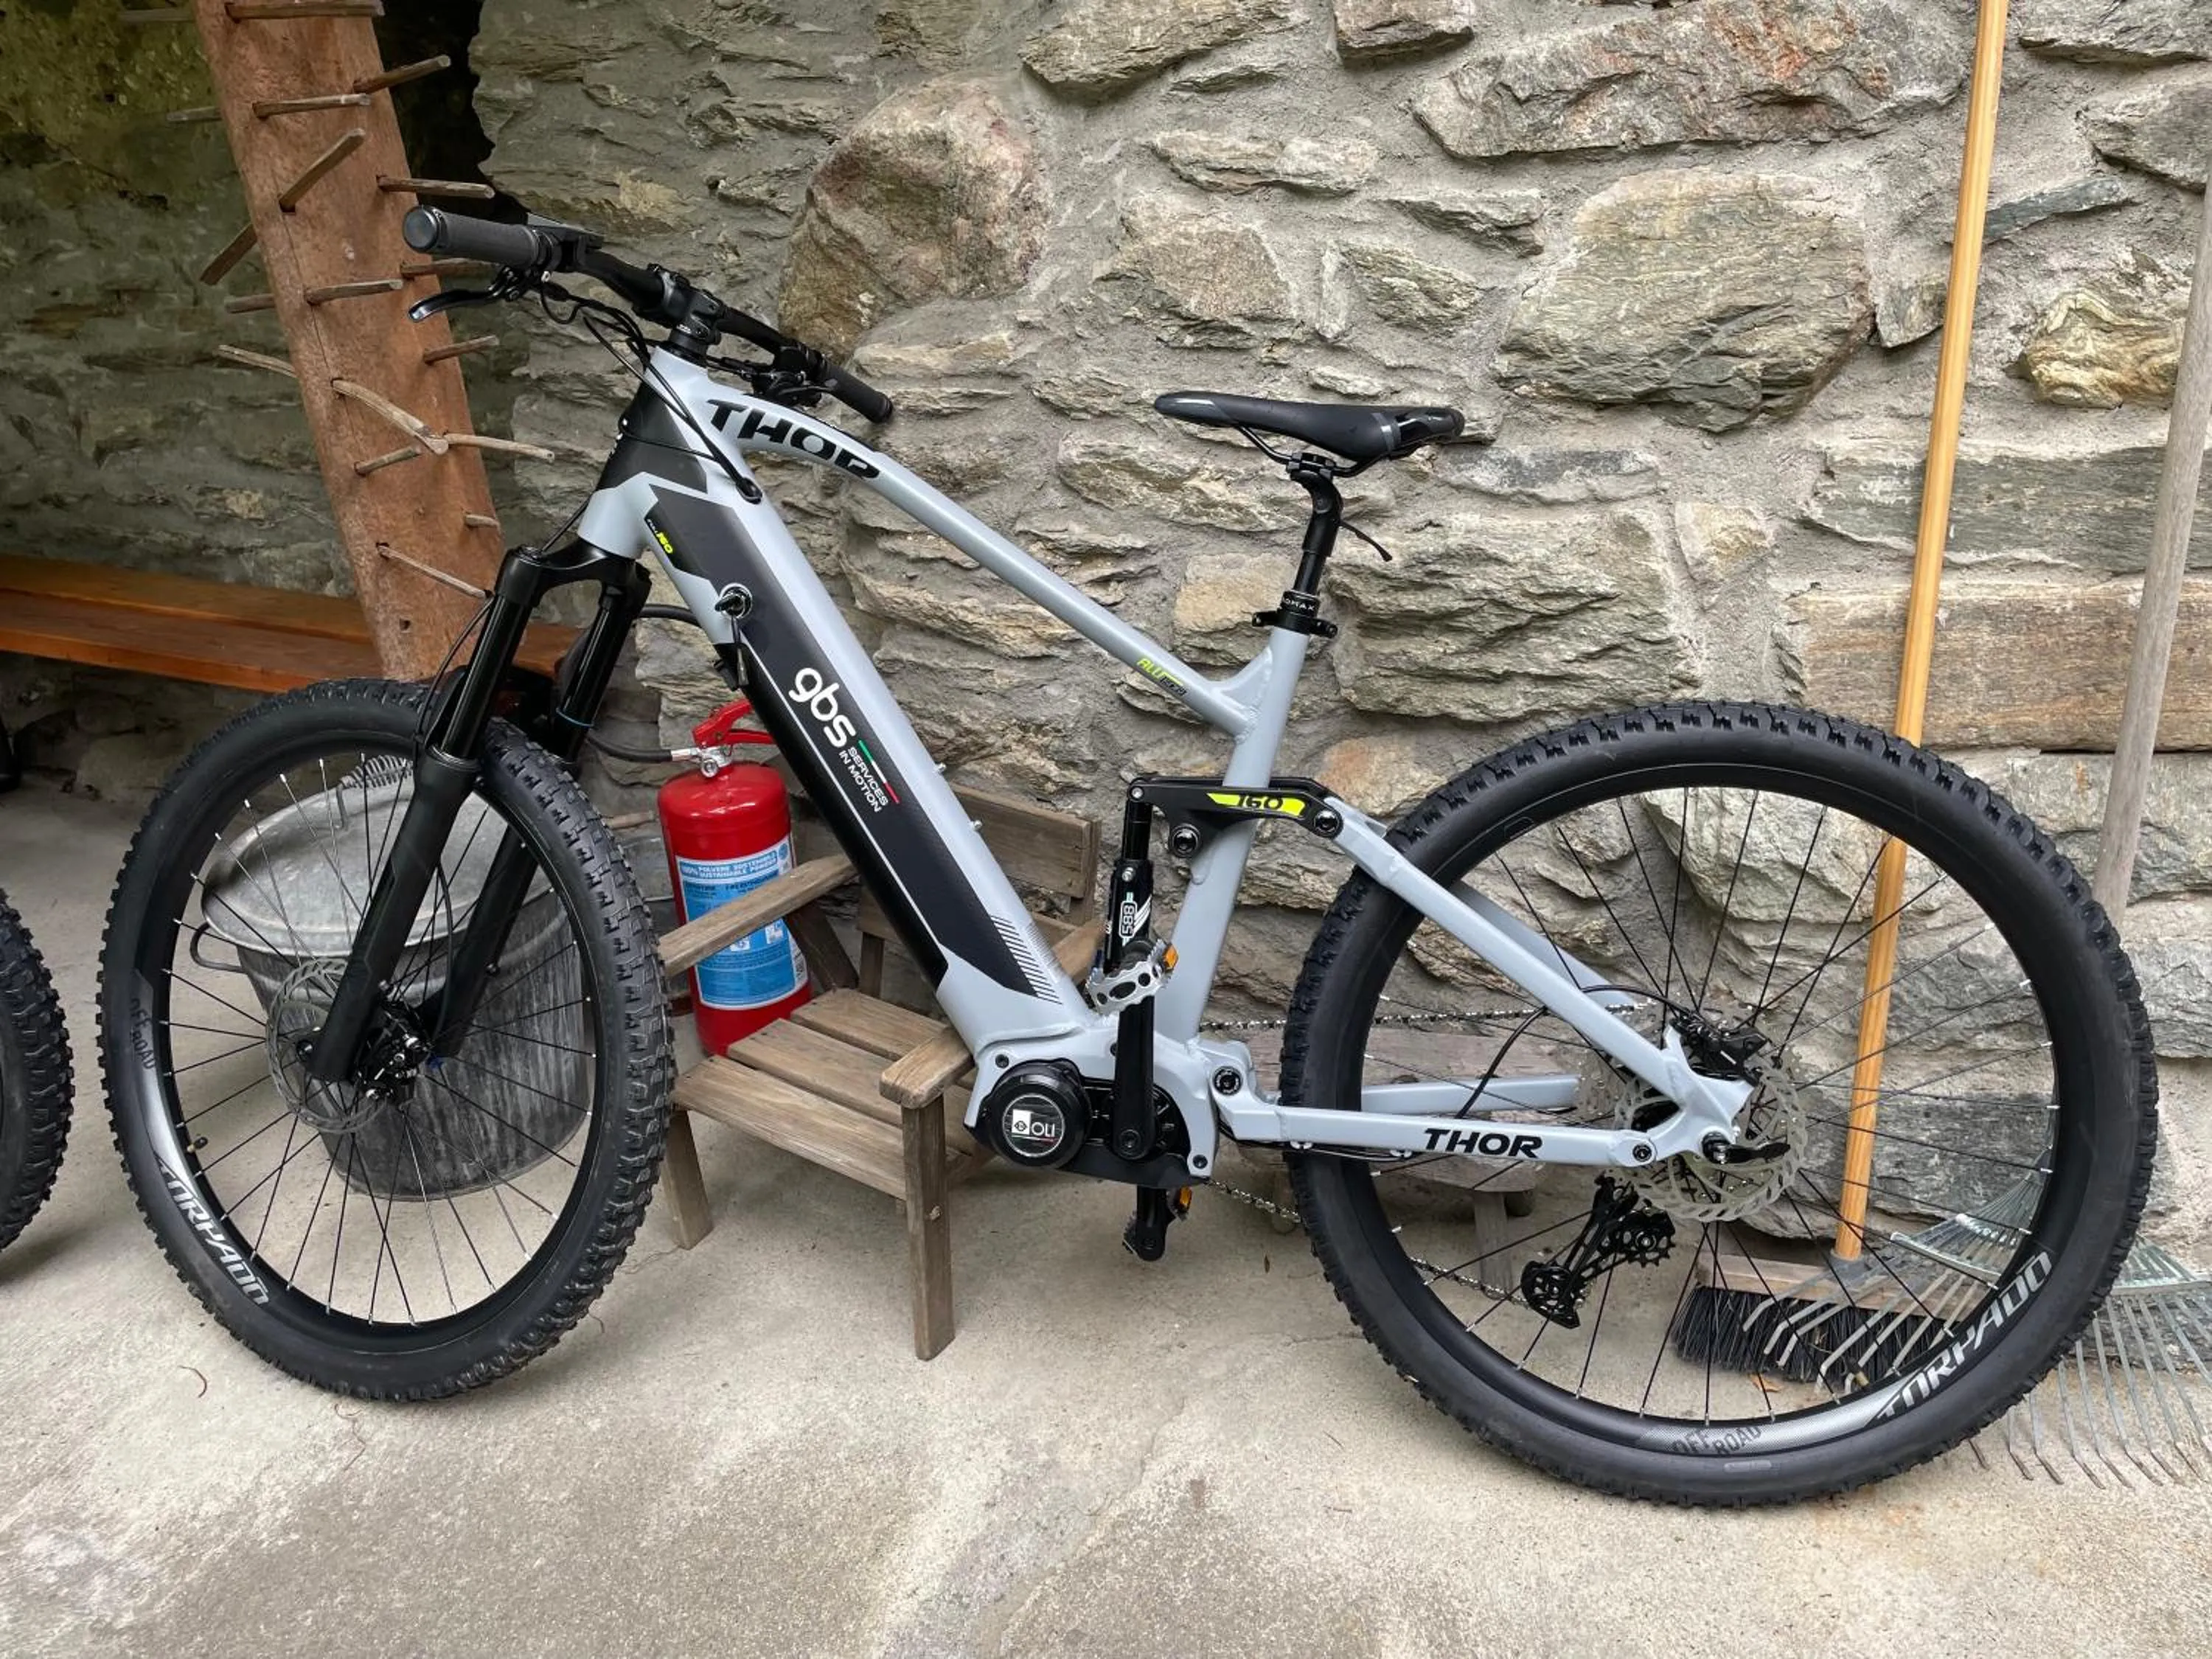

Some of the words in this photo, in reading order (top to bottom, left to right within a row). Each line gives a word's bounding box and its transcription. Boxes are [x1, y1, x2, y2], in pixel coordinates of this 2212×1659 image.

[788, 667, 857, 748] gbs
[838, 750, 852, 765] IN
[847, 765, 882, 813] MOTION
[848, 746, 888, 806] SERVICES
[1239, 794, 1284, 810] 160
[131, 1031, 156, 1070] ROAD
[1031, 1121, 1055, 1137] OLI
[1425, 1128, 1543, 1158] THOR
[1711, 1426, 1761, 1455] ROAD
